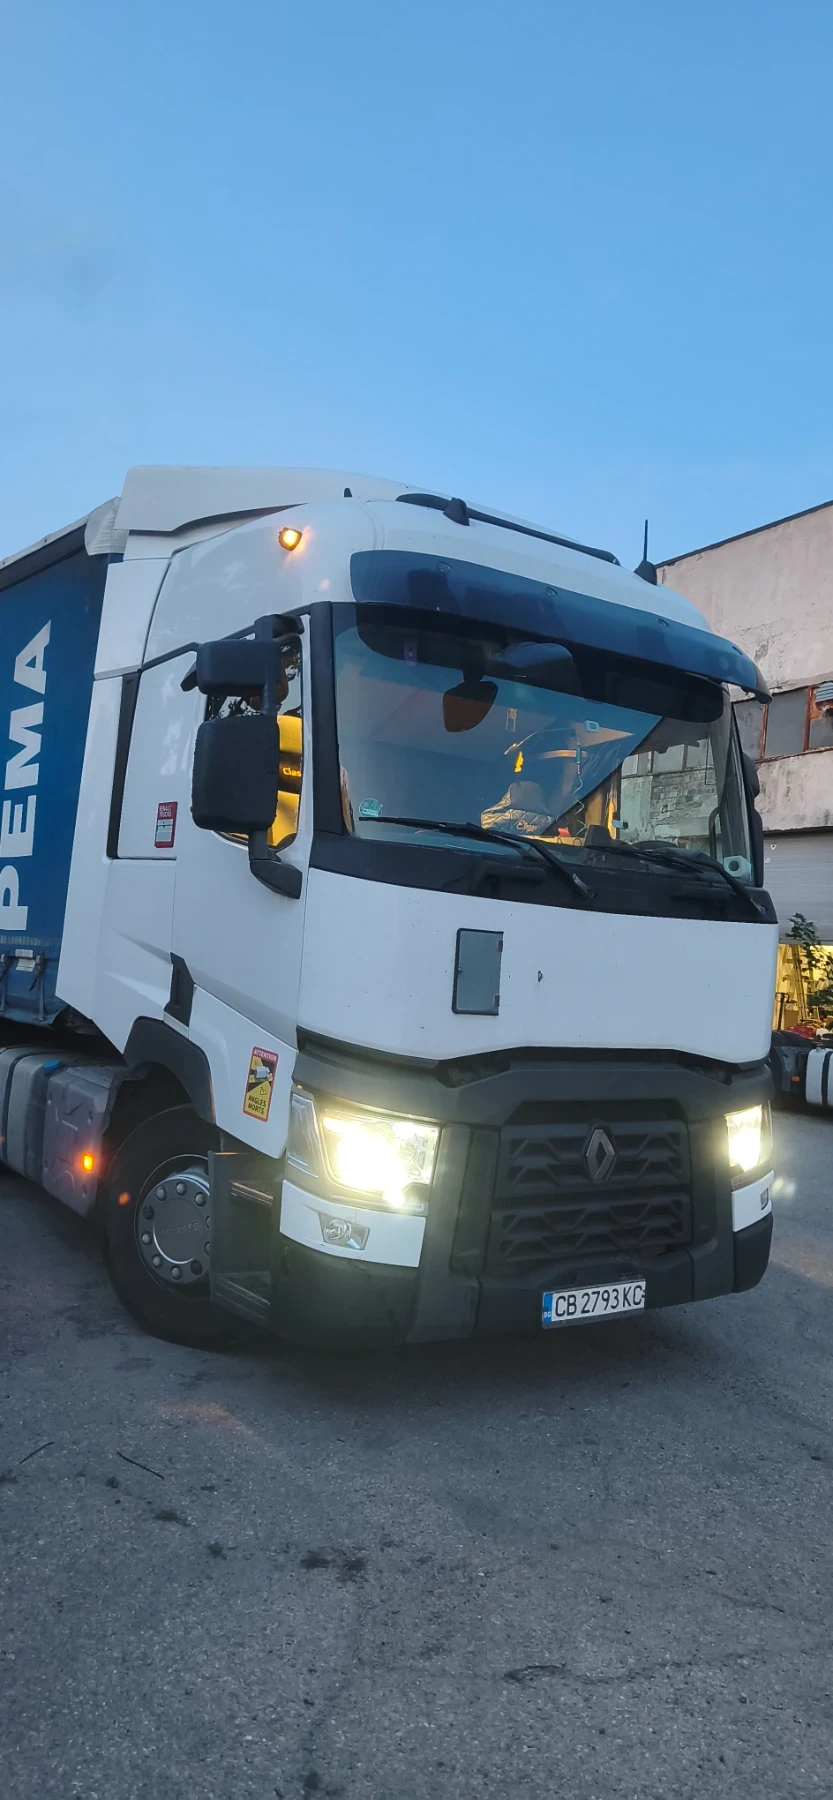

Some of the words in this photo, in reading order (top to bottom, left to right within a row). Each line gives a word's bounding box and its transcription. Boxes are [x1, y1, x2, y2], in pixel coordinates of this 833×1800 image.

[0, 619, 51, 930] PEMA
[247, 1102, 265, 1115] MORTS
[248, 1095, 267, 1108] ANGLES
[555, 1294, 577, 1317] CB
[581, 1288, 620, 1314] 2793
